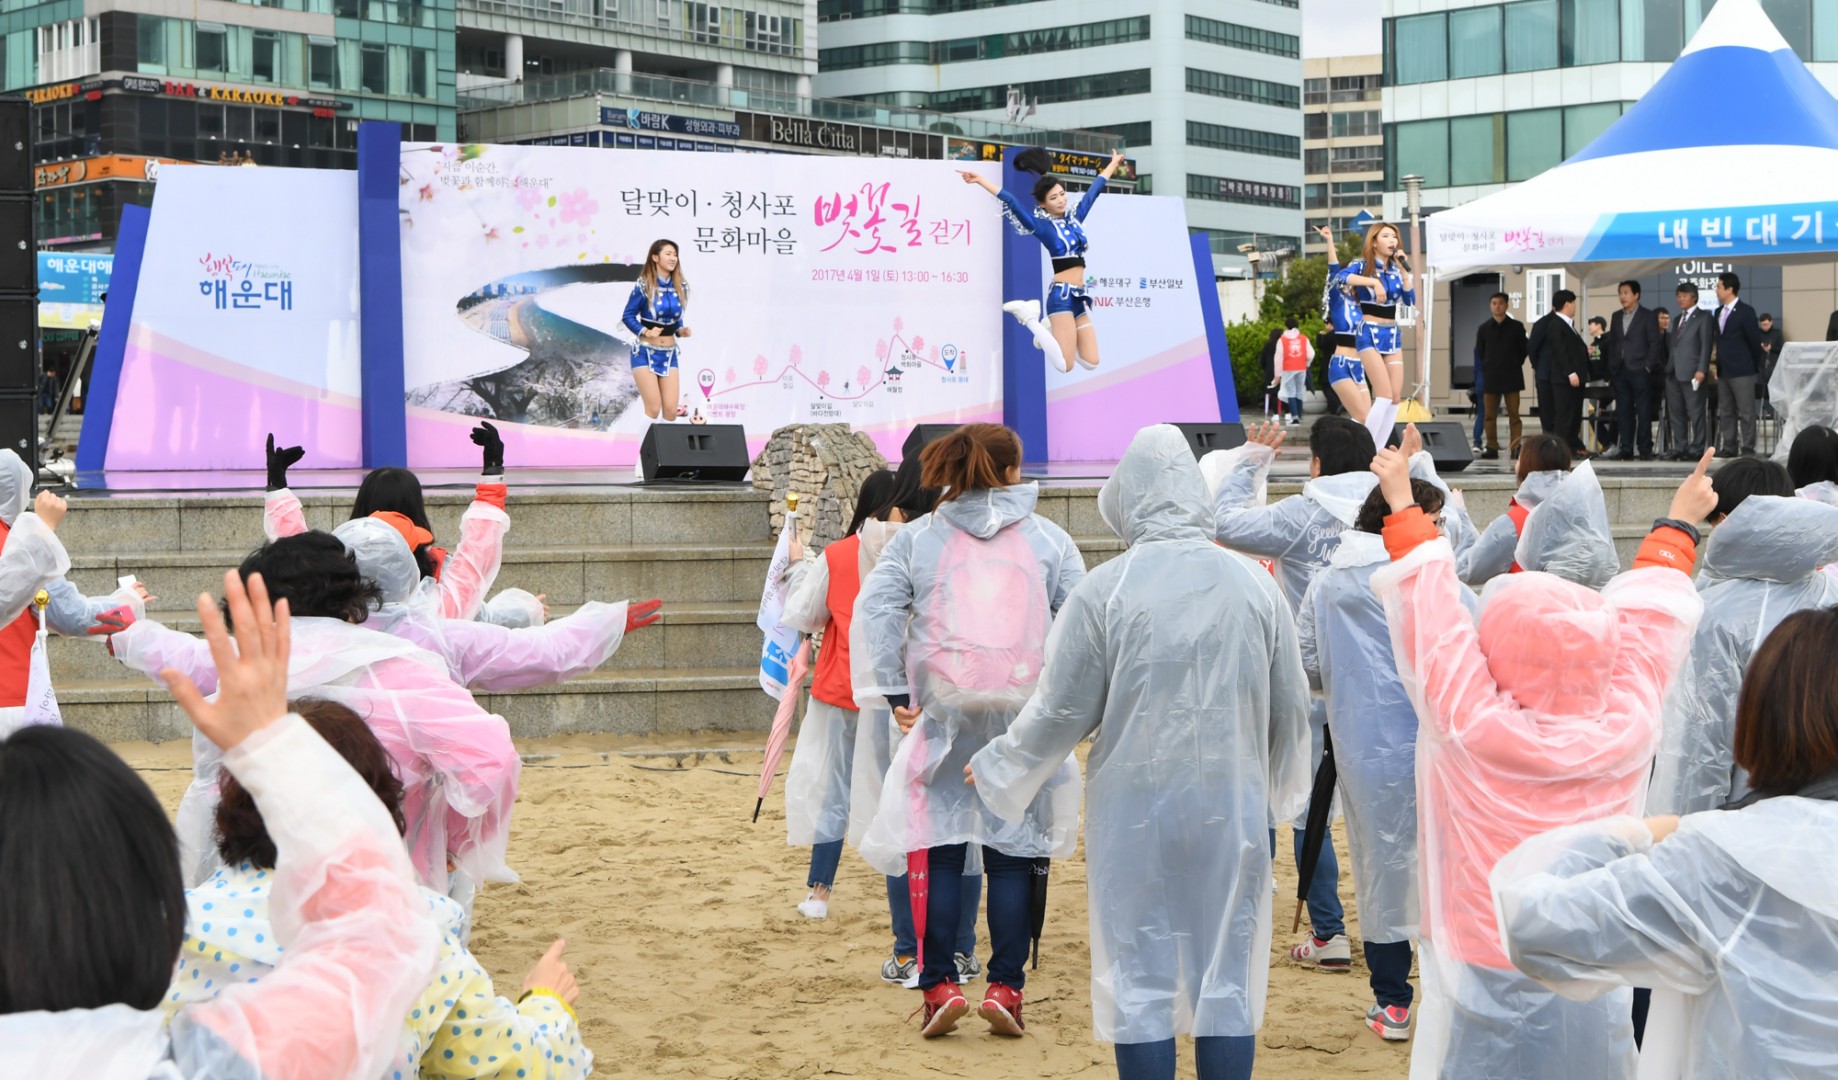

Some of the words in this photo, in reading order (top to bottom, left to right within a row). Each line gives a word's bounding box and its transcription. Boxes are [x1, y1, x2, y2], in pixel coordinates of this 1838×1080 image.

[164, 82, 196, 98] BAR
[210, 86, 284, 106] KARAOKE
[641, 112, 670, 131] 바람K
[772, 120, 813, 145] Bella
[817, 125, 855, 149] Citta
[620, 187, 697, 217] 달맞이
[721, 190, 797, 220] 청사포
[814, 182, 922, 254] 벚꽃길
[929, 218, 971, 247] 걷기
[1658, 210, 1838, 250] 내빈대기
[692, 226, 798, 255] 문화마을
[812, 269, 846, 282] 2017년
[847, 269, 863, 282] 4월
[866, 270, 880, 282] 1일
[883, 270, 898, 282] (토)
[902, 271, 930, 282] 13:00
[941, 272, 969, 283] 16:30
[1099, 278, 1132, 288] 해운대구
[1150, 278, 1184, 289] 부산일보
[199, 279, 292, 310] 해운대
[1115, 297, 1151, 308] 부산은행
